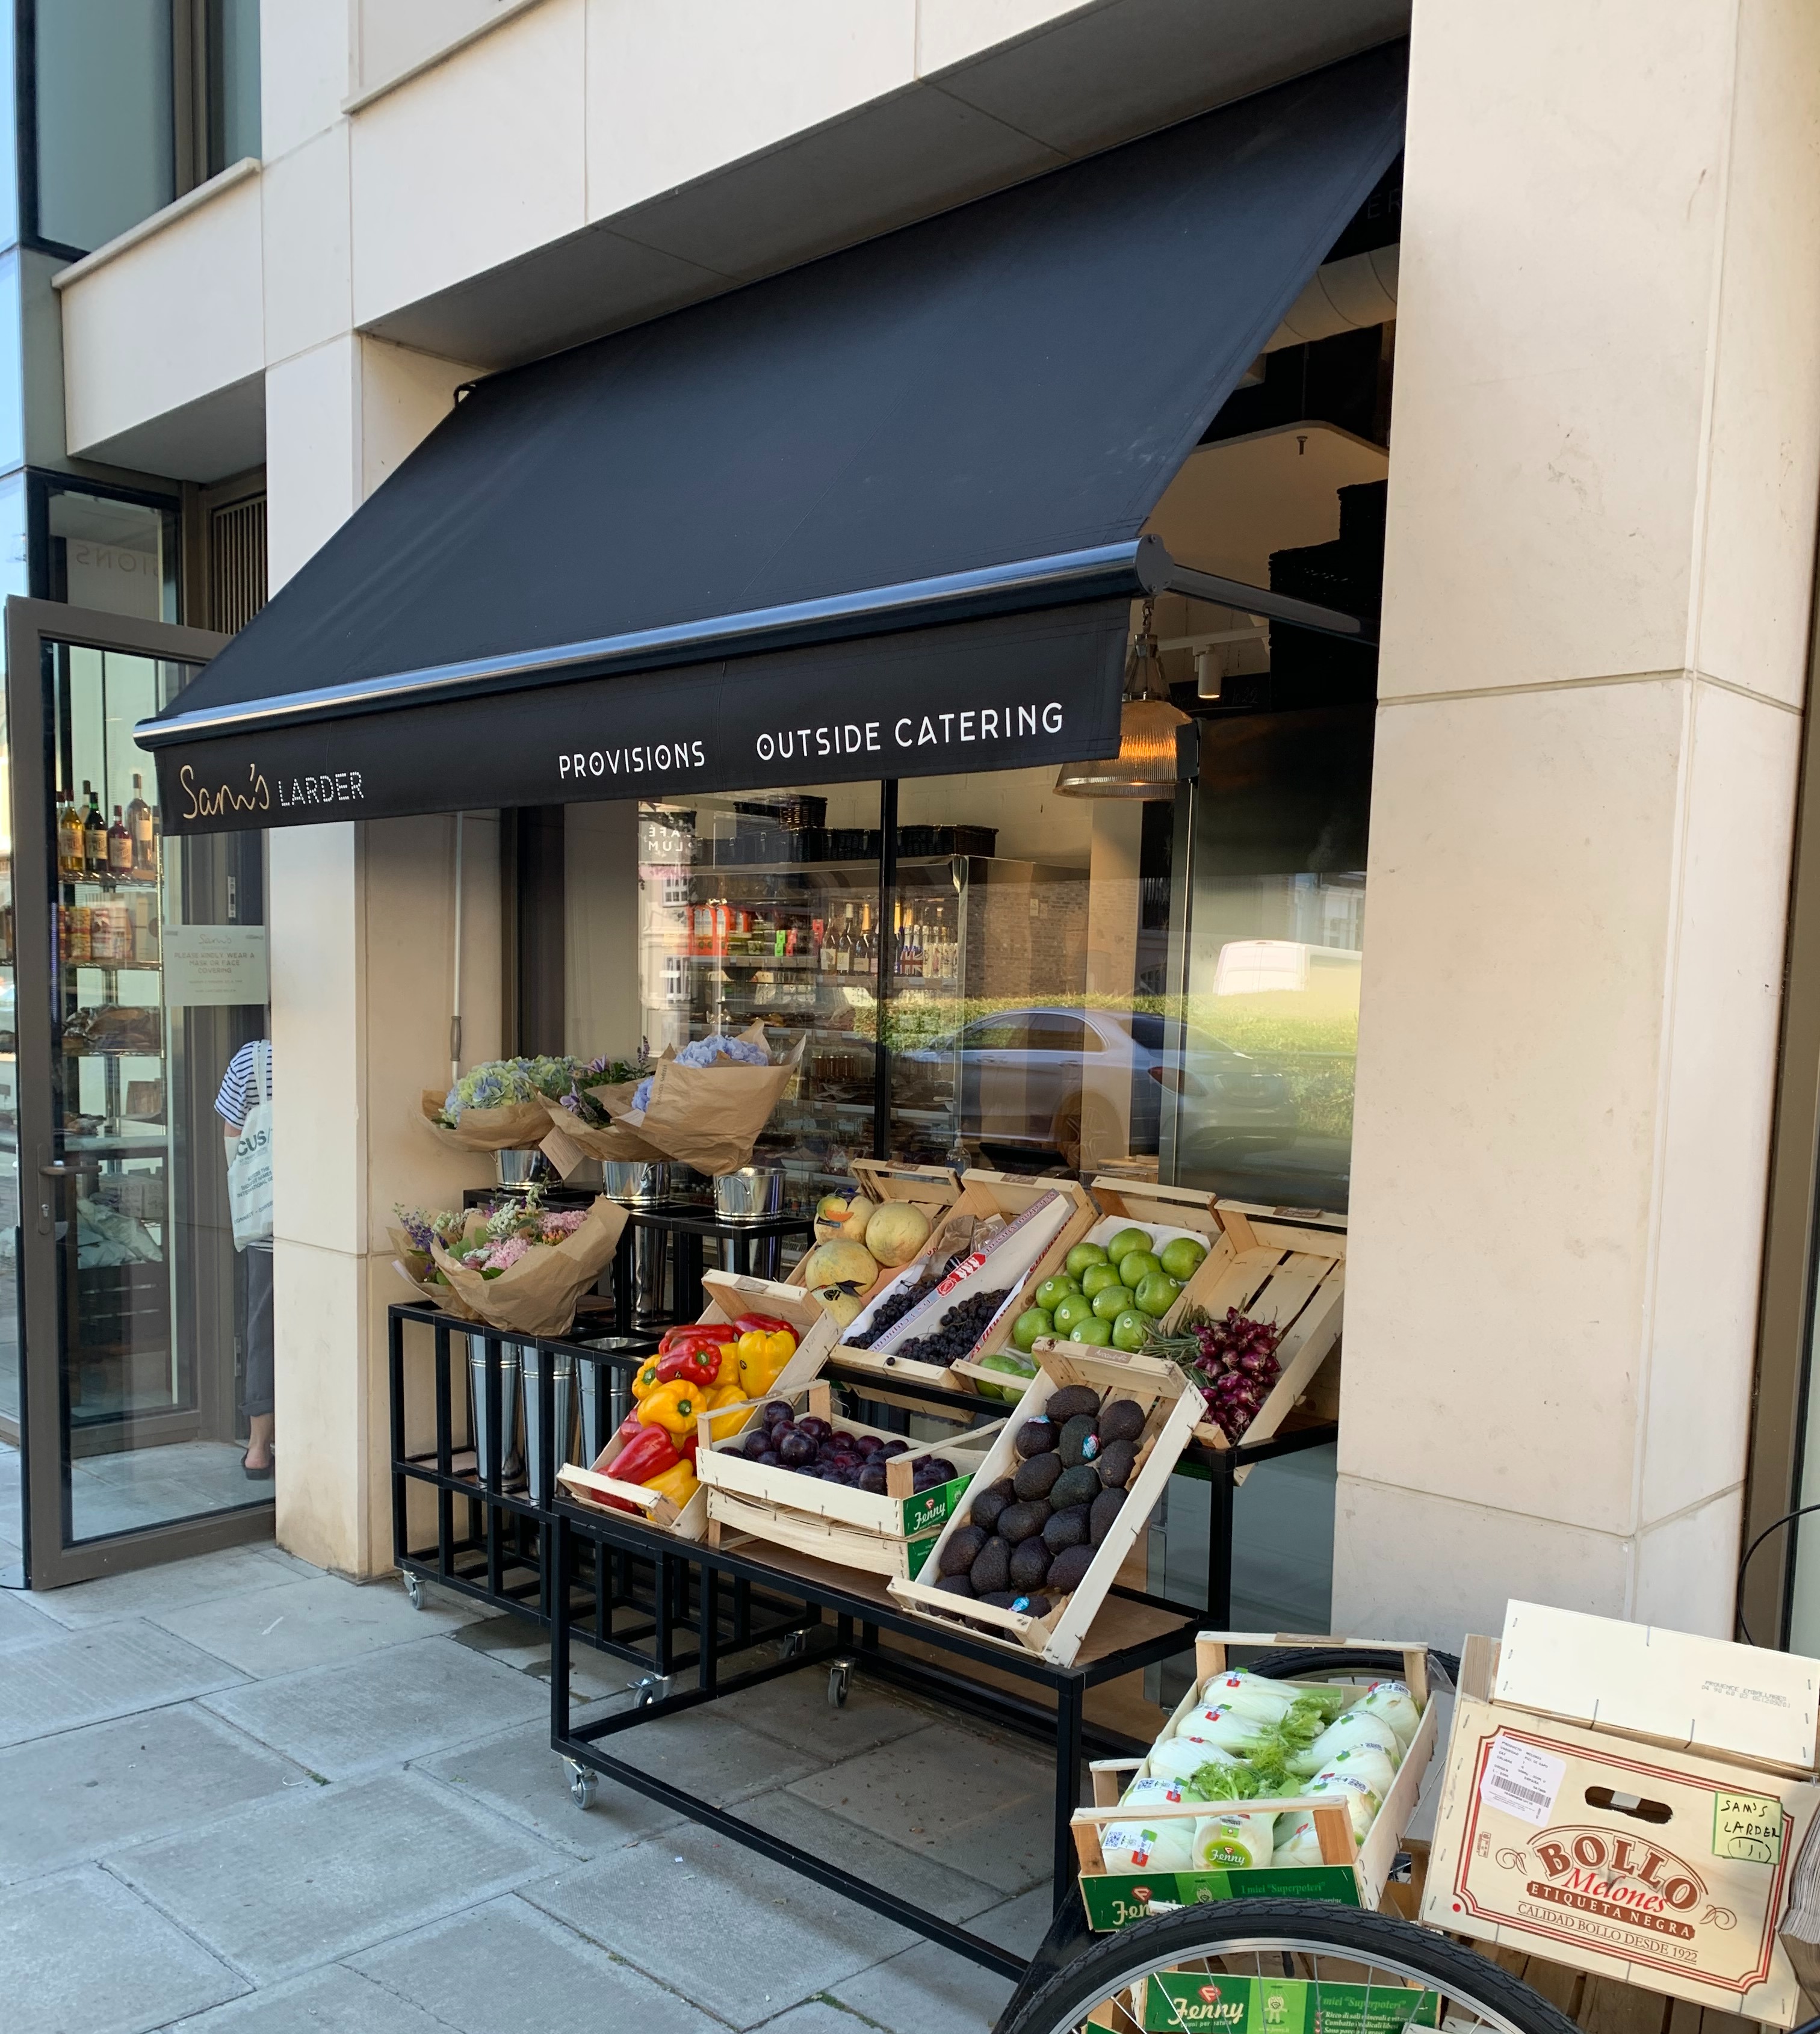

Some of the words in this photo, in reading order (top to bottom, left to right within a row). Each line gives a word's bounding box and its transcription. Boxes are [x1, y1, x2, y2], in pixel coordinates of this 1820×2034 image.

[756, 722, 882, 762] OUTSIDE
[894, 702, 1064, 748] CATERING
[558, 740, 706, 781] PROVISIONS
[180, 762, 270, 819] Sam's
[278, 771, 364, 806] LARDER
[914, 1502, 946, 1530] Fenny
[1704, 1680, 1739, 1692] PROVENCE
[1721, 1799, 1768, 1817] SAM'S
[1724, 1820, 1780, 1838] LARDER
[1209, 1849, 1245, 1866] Fenny
[1533, 1833, 1701, 1913] BOLLO
[1561, 1867, 1670, 1913] Melones
[1531, 1884, 1622, 1919] ETIQUETA
[1630, 1911, 1691, 1939] NEGRA
[1518, 1903, 1575, 1927] CALIDAD
[1578, 1919, 1622, 1941] BOLLO
[1623, 1931, 1669, 1956] DESDE
[1673, 1946, 1698, 1963] 1922
[1168, 1997, 1244, 2026] Fenny
